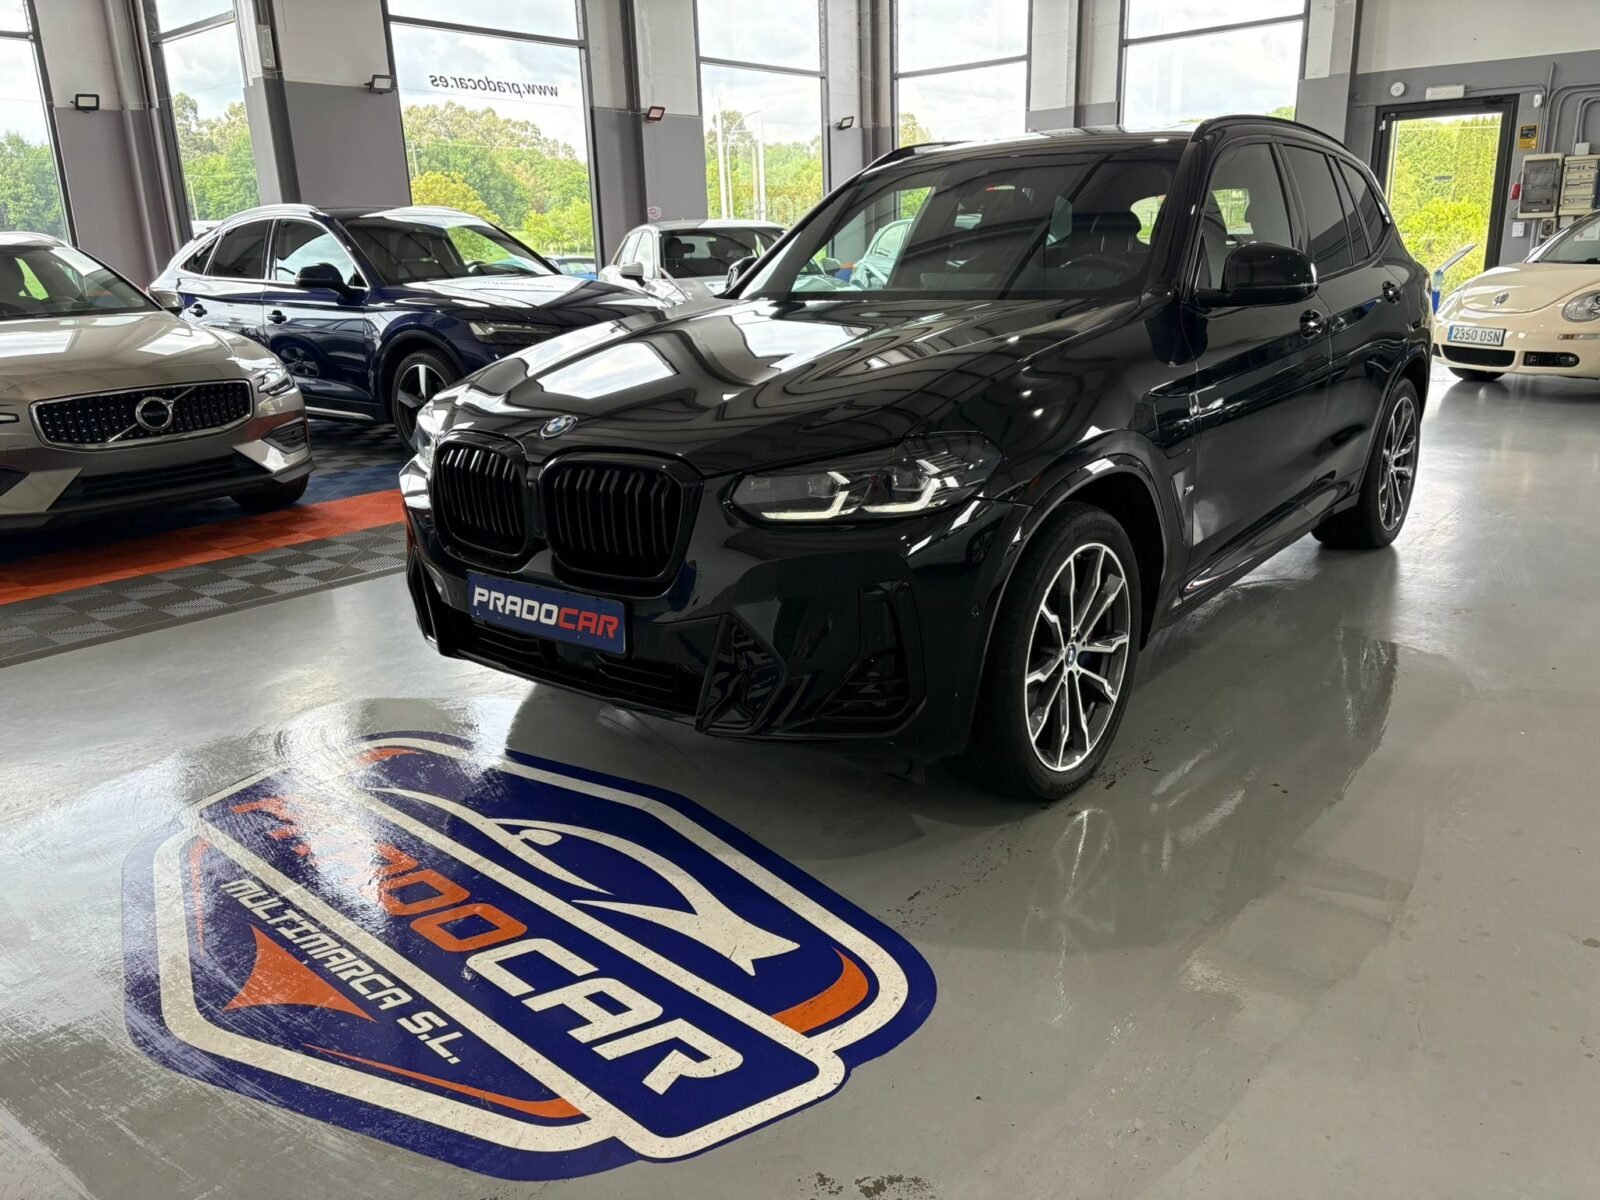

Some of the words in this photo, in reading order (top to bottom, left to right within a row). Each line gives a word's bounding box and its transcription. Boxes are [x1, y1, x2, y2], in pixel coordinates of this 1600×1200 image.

[1453, 328, 1478, 341] 2350
[1480, 330, 1501, 343] DSN
[472, 585, 619, 638] PRADOCAR
[220, 879, 413, 1010] MULTIMARCA
[396, 1010, 464, 1064] S.L.
